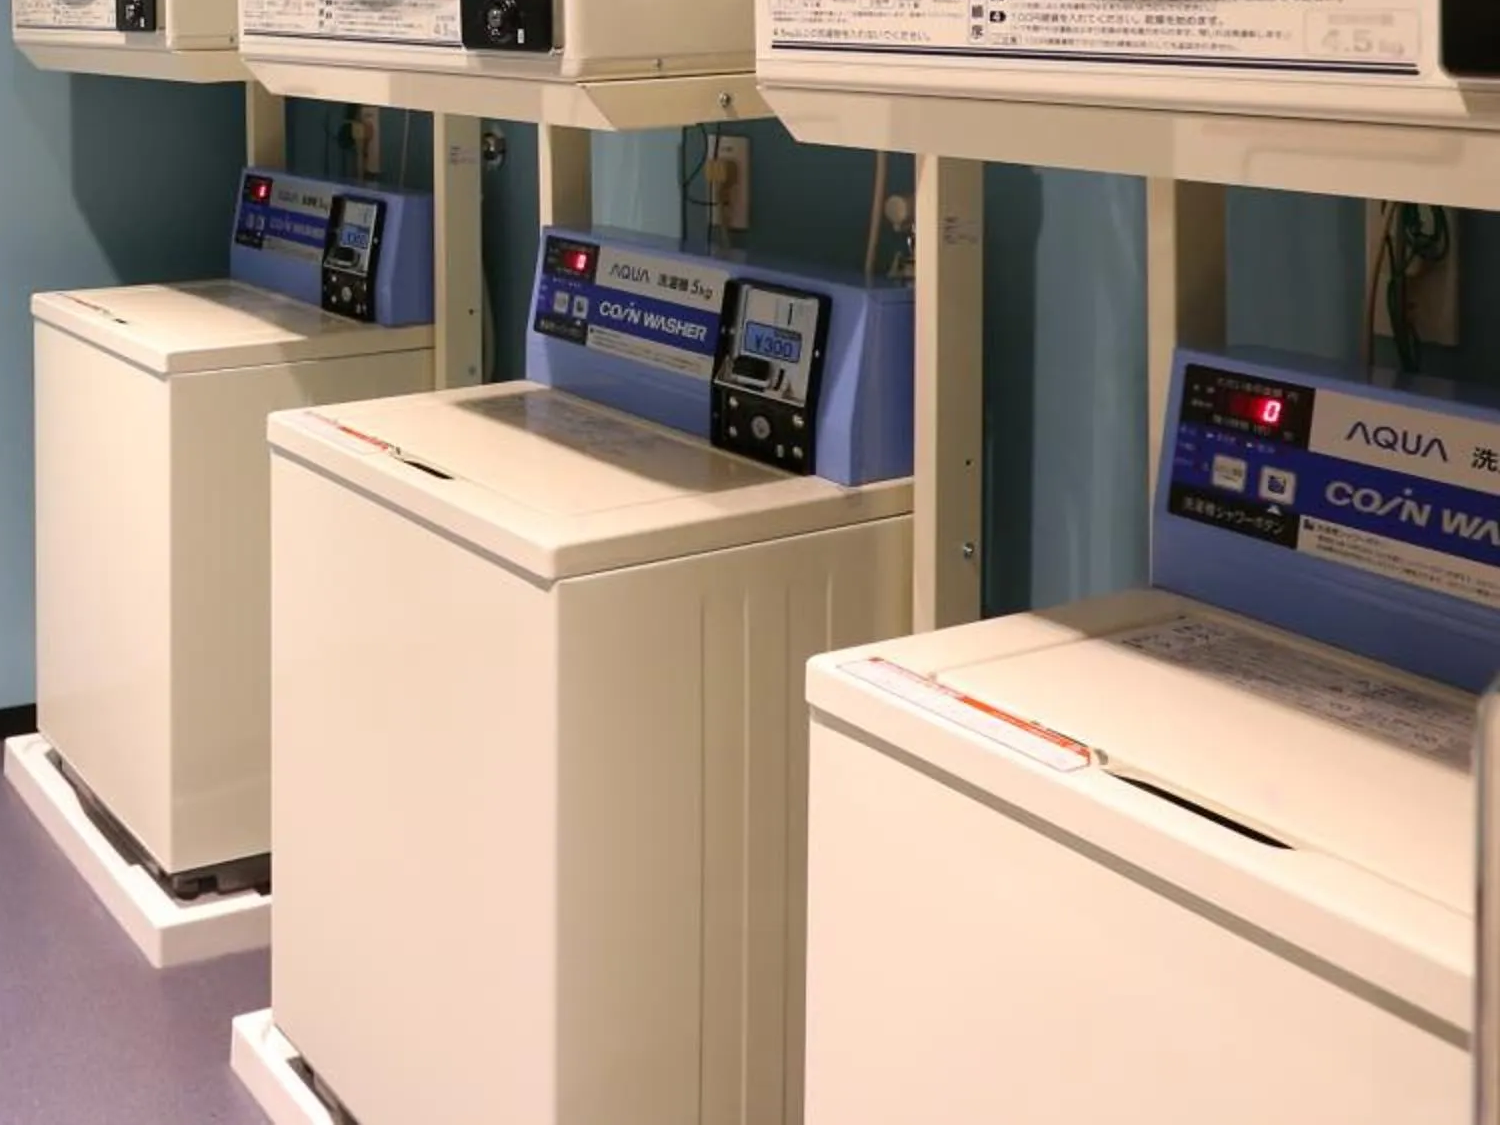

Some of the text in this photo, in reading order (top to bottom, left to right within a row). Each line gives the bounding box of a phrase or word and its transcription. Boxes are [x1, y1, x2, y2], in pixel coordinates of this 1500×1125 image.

[1321, 29, 1373, 54] 4.5
[609, 263, 650, 284] AQUA
[691, 278, 713, 300] 5kg
[599, 301, 708, 342] COIN WASHER
[1262, 399, 1282, 424] 0
[1345, 421, 1449, 463] AQUA
[1325, 480, 1433, 528] COIN
